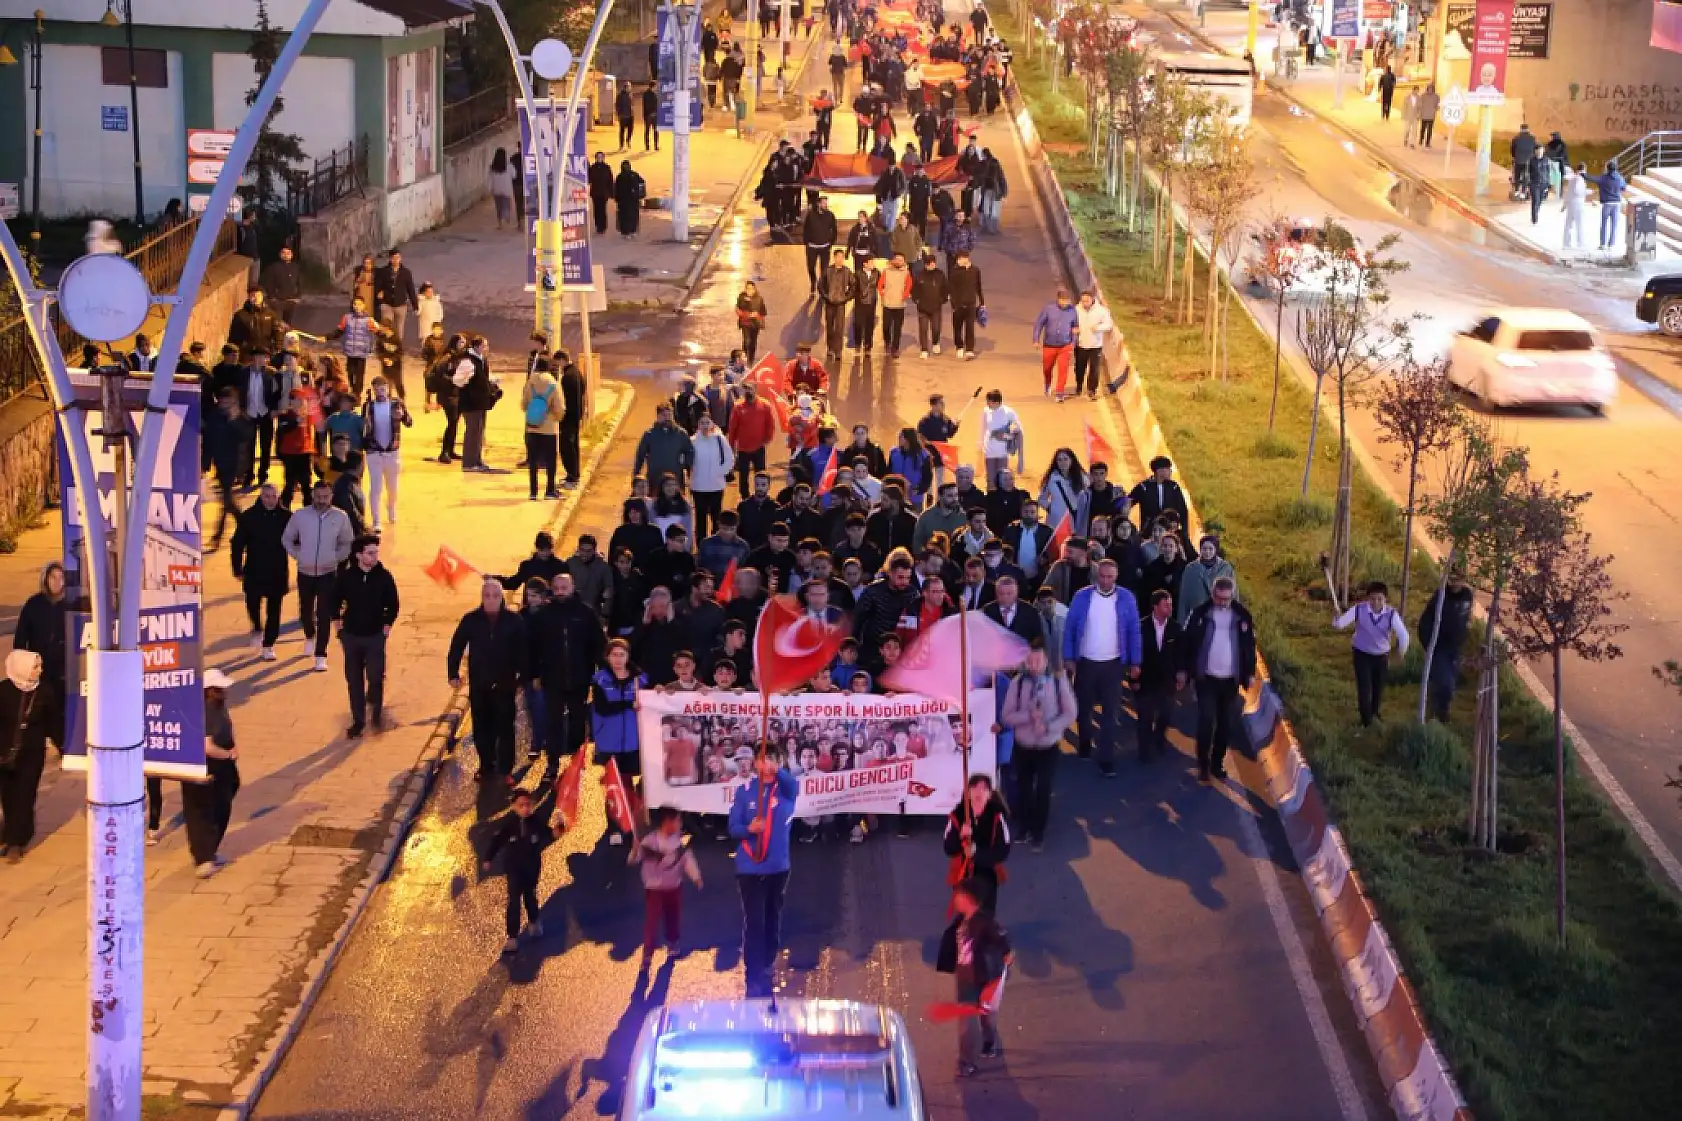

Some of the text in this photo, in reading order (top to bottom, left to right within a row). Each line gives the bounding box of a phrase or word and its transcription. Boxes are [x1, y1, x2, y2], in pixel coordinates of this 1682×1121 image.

[1445, 107, 1461, 120] 30
[684, 701, 717, 714] AĞRI
[720, 703, 780, 717] GENÇLK
[784, 705, 801, 717] VE
[805, 705, 842, 717] SPOR
